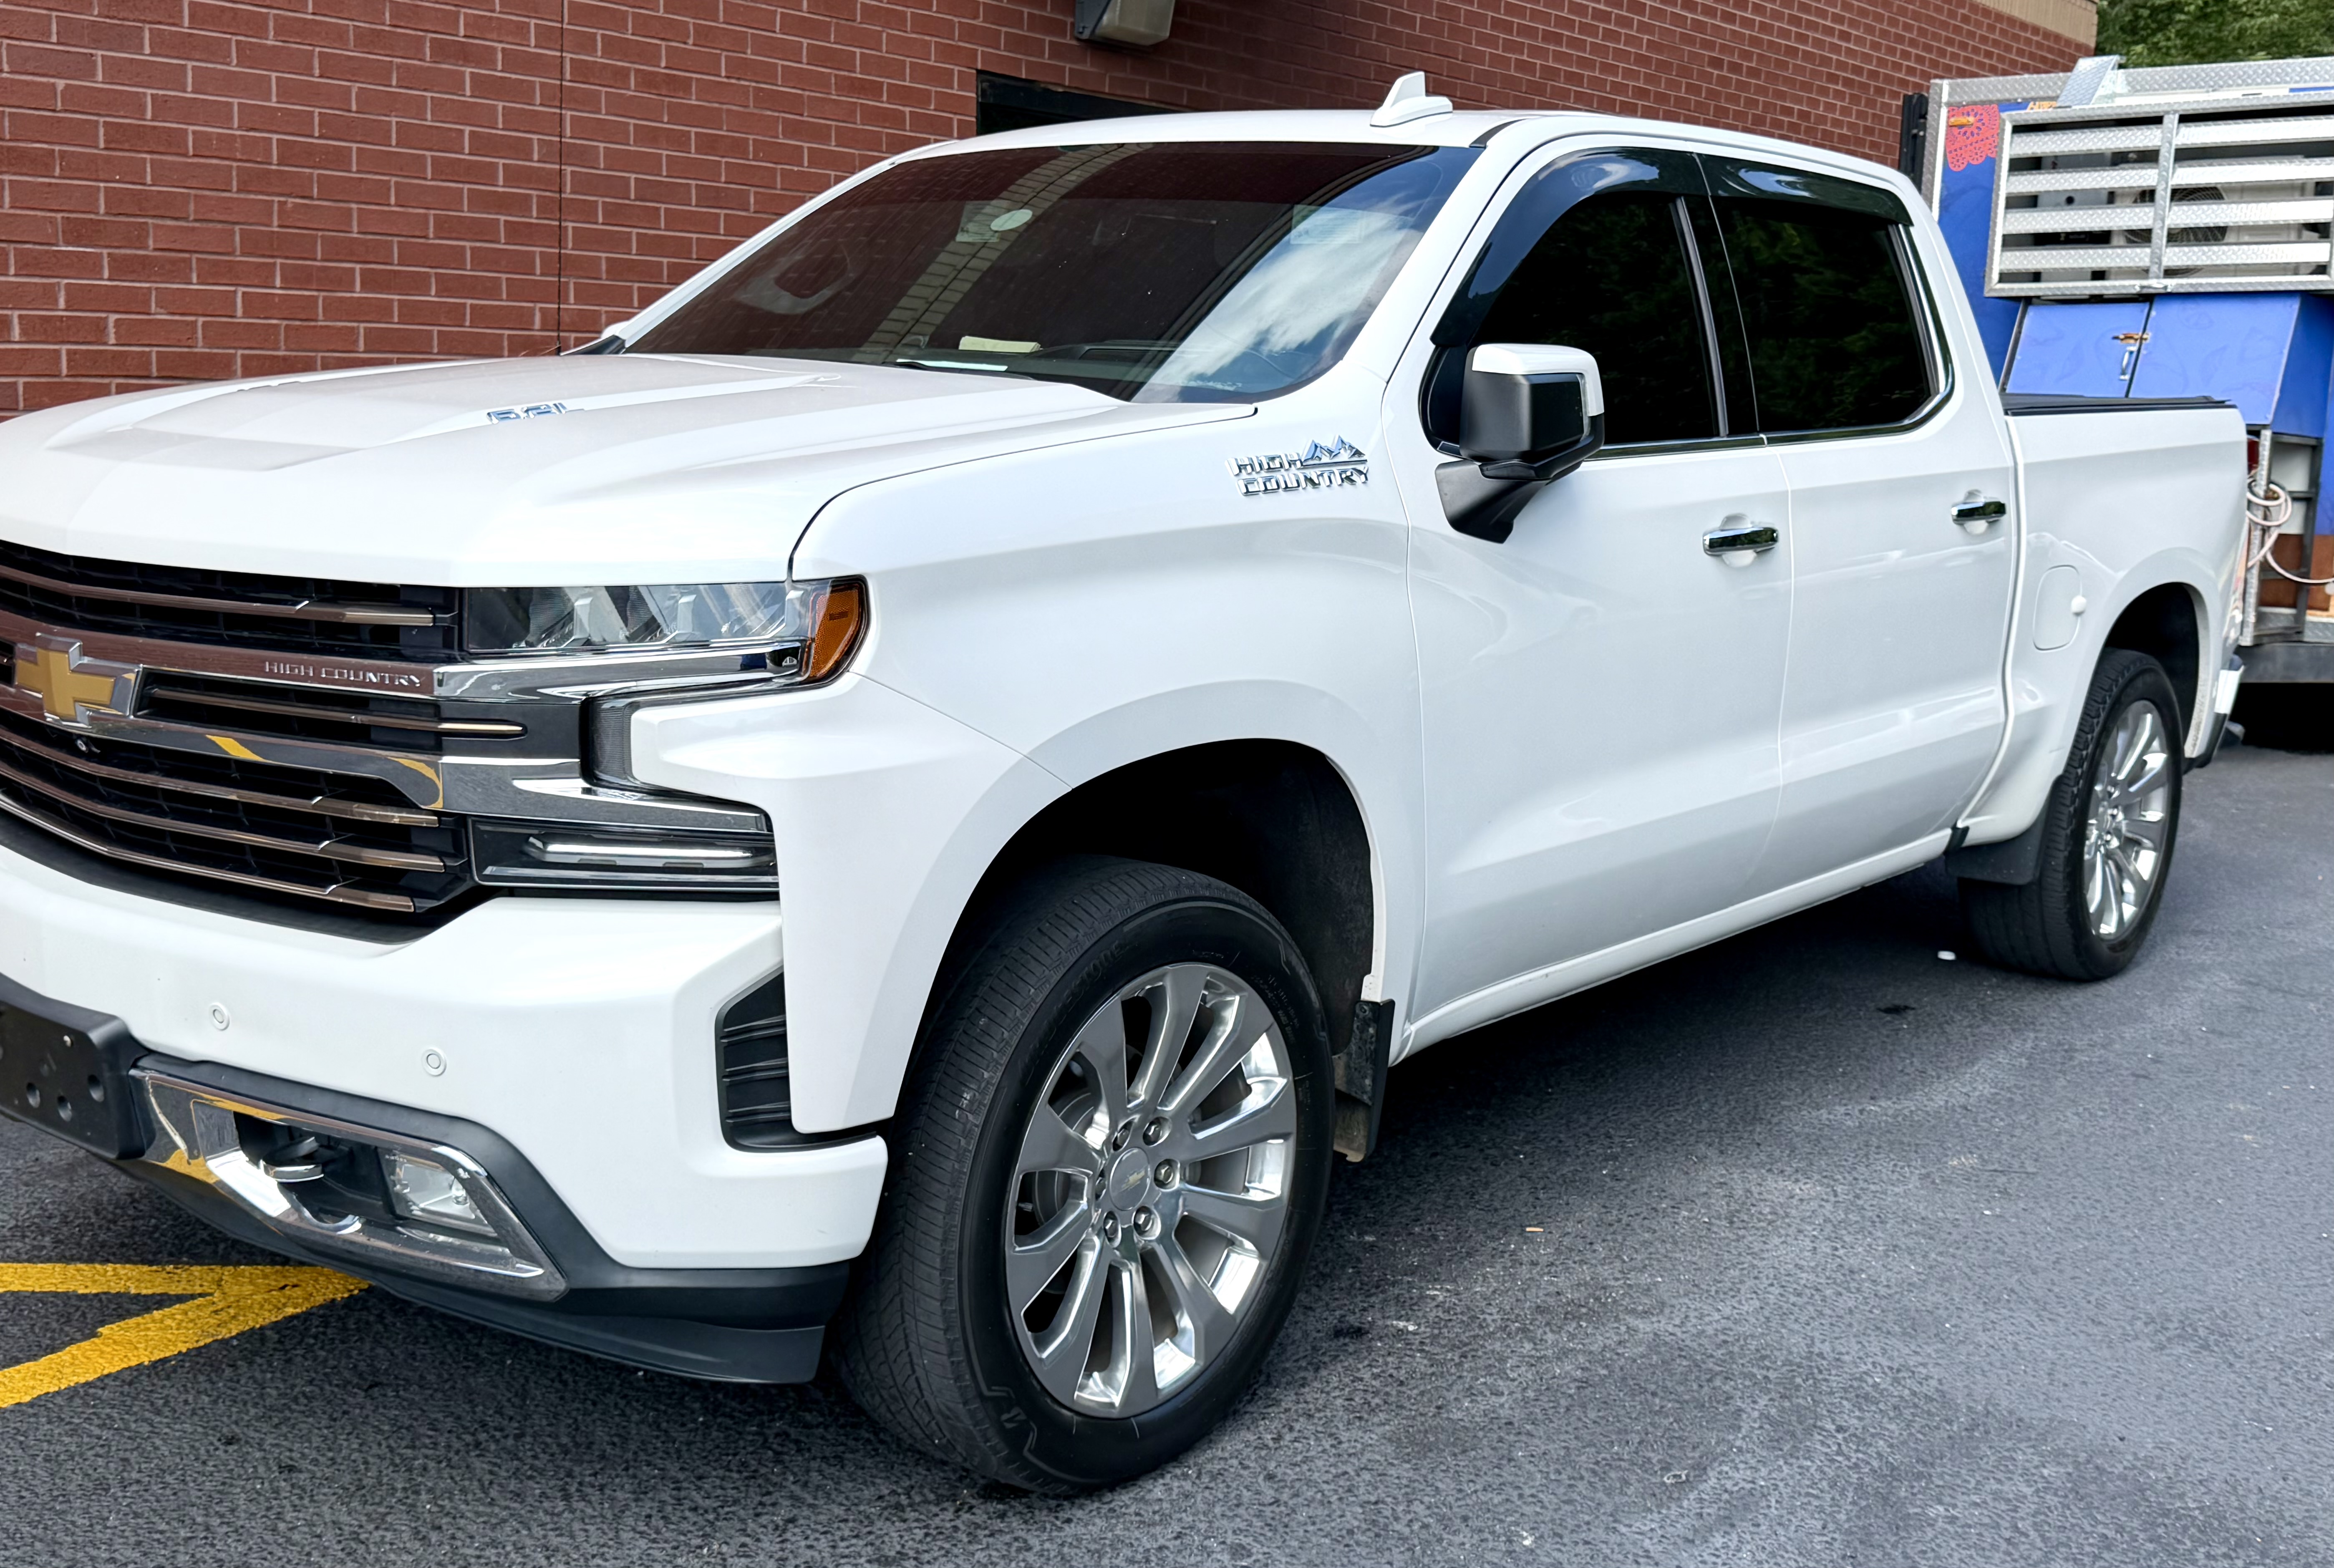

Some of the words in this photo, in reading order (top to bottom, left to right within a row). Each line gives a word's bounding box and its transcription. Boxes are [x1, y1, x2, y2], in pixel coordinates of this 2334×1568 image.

[1225, 452, 1303, 476] HIGH
[1236, 466, 1369, 496] COUNTRY
[265, 661, 313, 677] HIGH
[320, 667, 425, 687] COUNTRY
